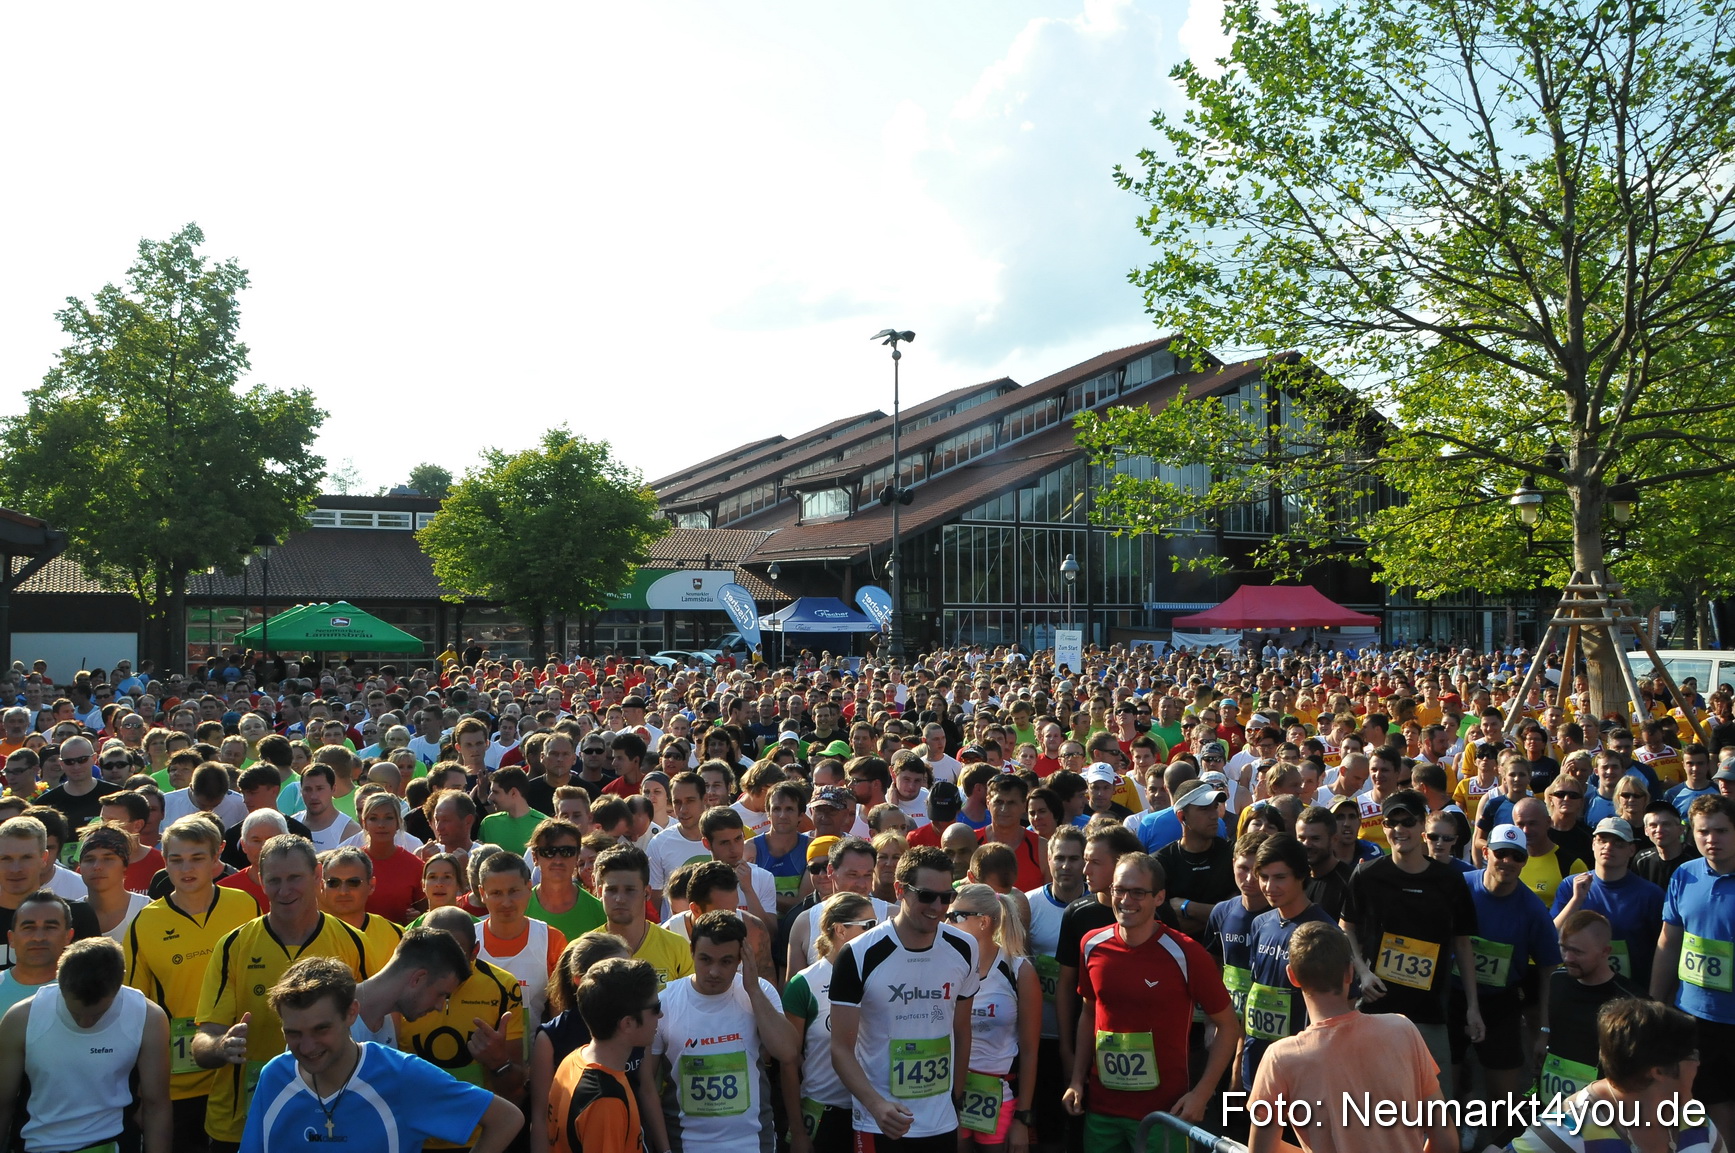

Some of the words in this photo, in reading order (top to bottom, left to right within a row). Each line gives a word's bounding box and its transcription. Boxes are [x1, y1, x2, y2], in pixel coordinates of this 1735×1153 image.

[1225, 933, 1245, 944] EURO
[1381, 949, 1433, 978] 1133
[1473, 953, 1500, 975] 21
[1685, 951, 1722, 977] 678
[1247, 1007, 1287, 1035] 5087
[701, 1033, 743, 1046] KLEBL
[893, 1056, 949, 1085] 1433
[1104, 1052, 1147, 1077] 602
[690, 1074, 739, 1101] 558
